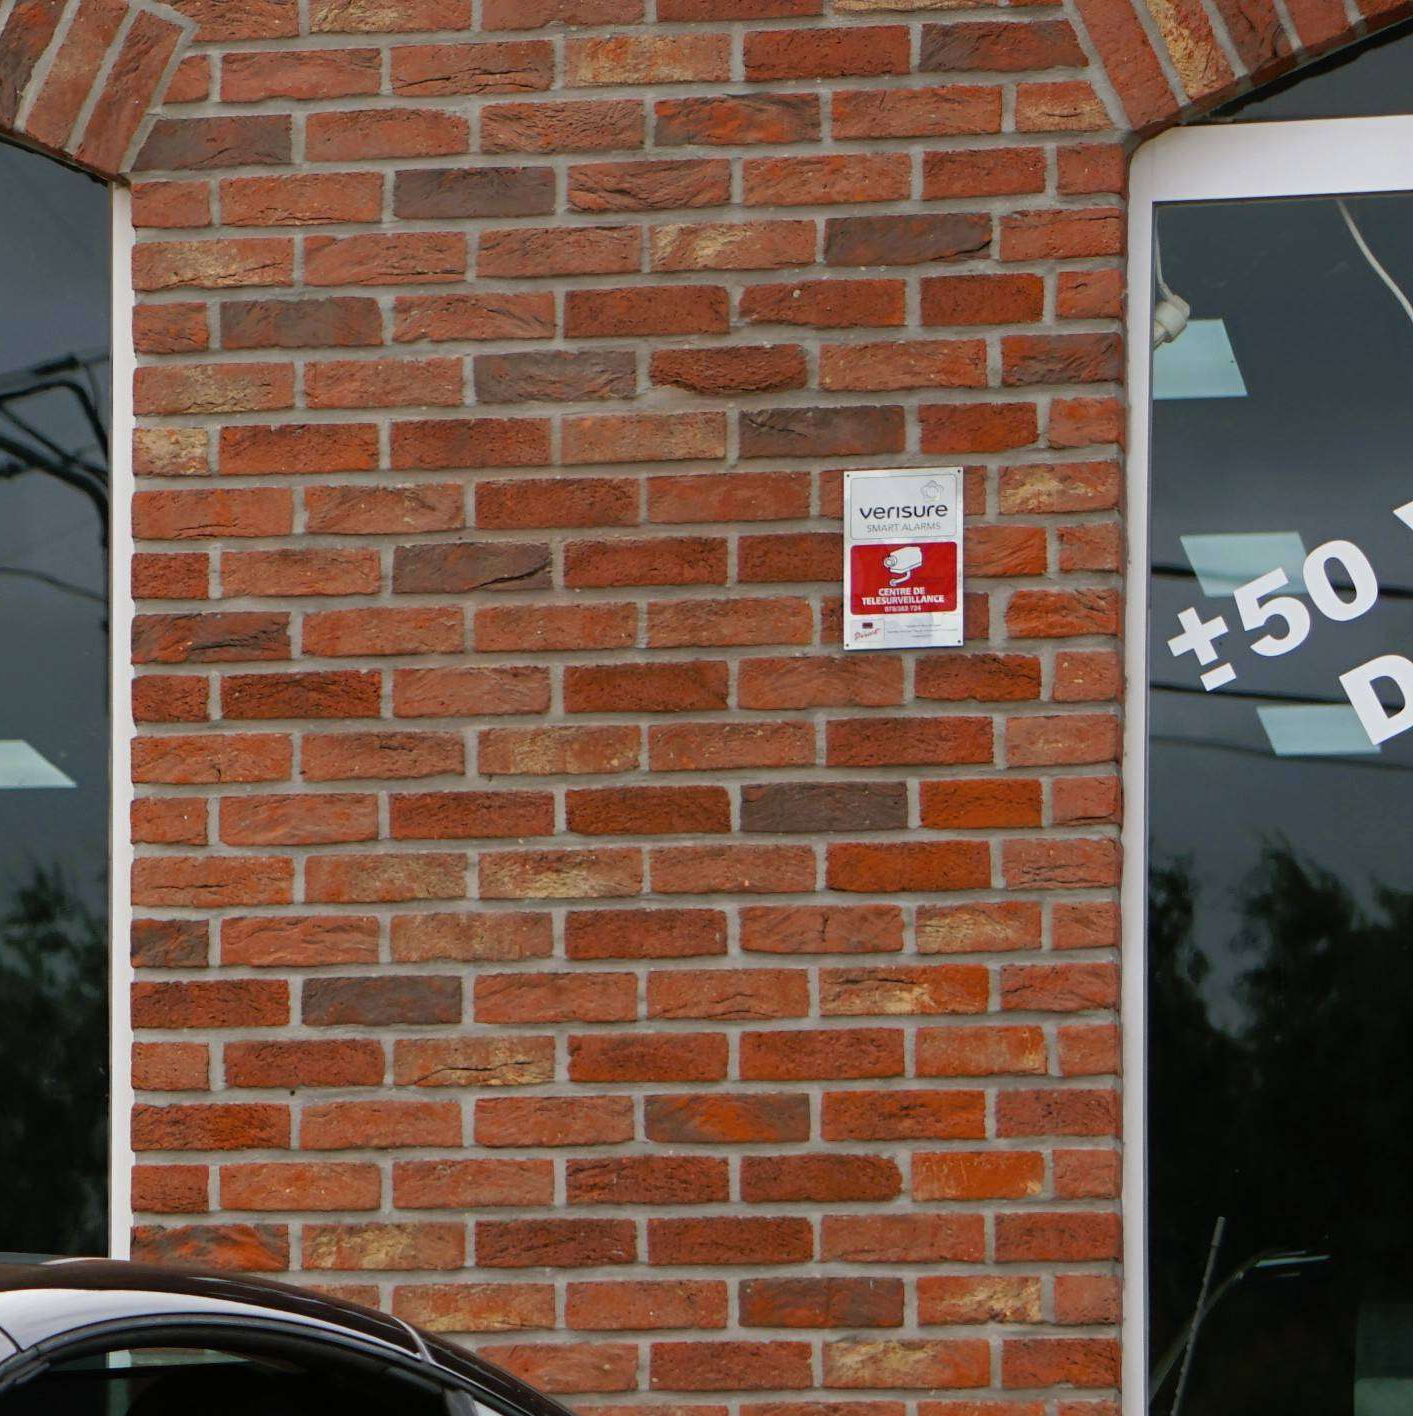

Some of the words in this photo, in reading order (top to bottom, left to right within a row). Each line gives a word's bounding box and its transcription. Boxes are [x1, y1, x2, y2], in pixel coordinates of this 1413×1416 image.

[859, 503, 948, 520] verisure
[866, 523, 900, 533] SMART
[902, 521, 942, 532] ALARMS
[878, 587, 911, 597] CENTRE
[913, 586, 926, 596] DE
